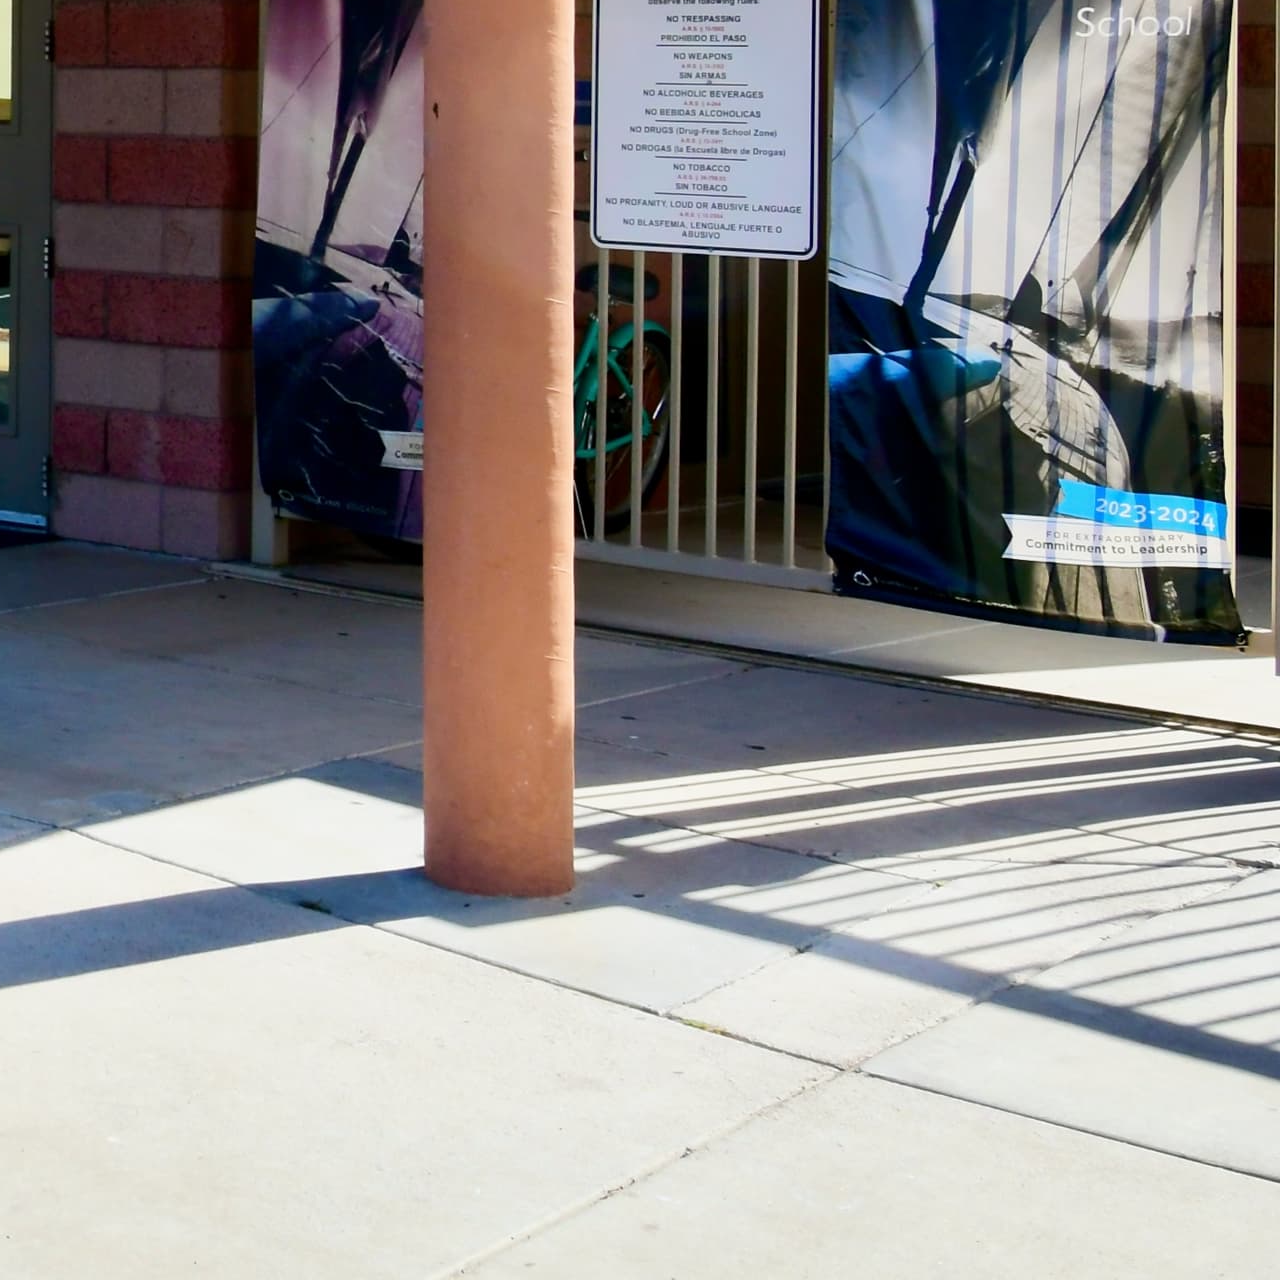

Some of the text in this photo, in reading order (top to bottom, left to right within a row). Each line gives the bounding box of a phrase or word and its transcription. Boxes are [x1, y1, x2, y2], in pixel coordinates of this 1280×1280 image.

[666, 15, 741, 23] NO TRESPASSING
[1075, 6, 1193, 38] School
[660, 34, 747, 42] PROHIBIDO EL PASO
[673, 52, 733, 60] NO WEAPONS
[643, 89, 764, 99] NO ALCOHOLIC BEVERAGES
[645, 108, 761, 118] NO BEBIDAS ALCOHOLICAS
[644, 126, 674, 134] DRUGS
[676, 127, 720, 136] (Drug-Free
[722, 128, 751, 136] School
[753, 129, 777, 137] Zone)
[621, 143, 634, 151] NO
[635, 144, 672, 152] DROGAS
[686, 146, 718, 154] Escuela
[720, 146, 737, 154] libre
[740, 147, 750, 155] de
[752, 147, 786, 157] Drogas)
[673, 163, 731, 172] NO TOBACCO
[675, 182, 728, 192] SIN TOBACO
[605, 197, 618, 205] NO
[670, 200, 693, 209] LOUD
[696, 201, 708, 209] OR
[711, 202, 749, 211] ABUSIVE
[751, 204, 802, 214] LANGUAGE
[623, 218, 635, 226] NO
[690, 221, 737, 232] LENGUAJE
[739, 224, 773, 233] FUERTE
[775, 226, 782, 234] O
[682, 230, 721, 239] ABUSIVO
[1095, 498, 1216, 531] 2023-2024
[1046, 530, 1184, 543] FOR EXTRAORDINARY
[1026, 539, 1208, 556] Commitment to Leadership
